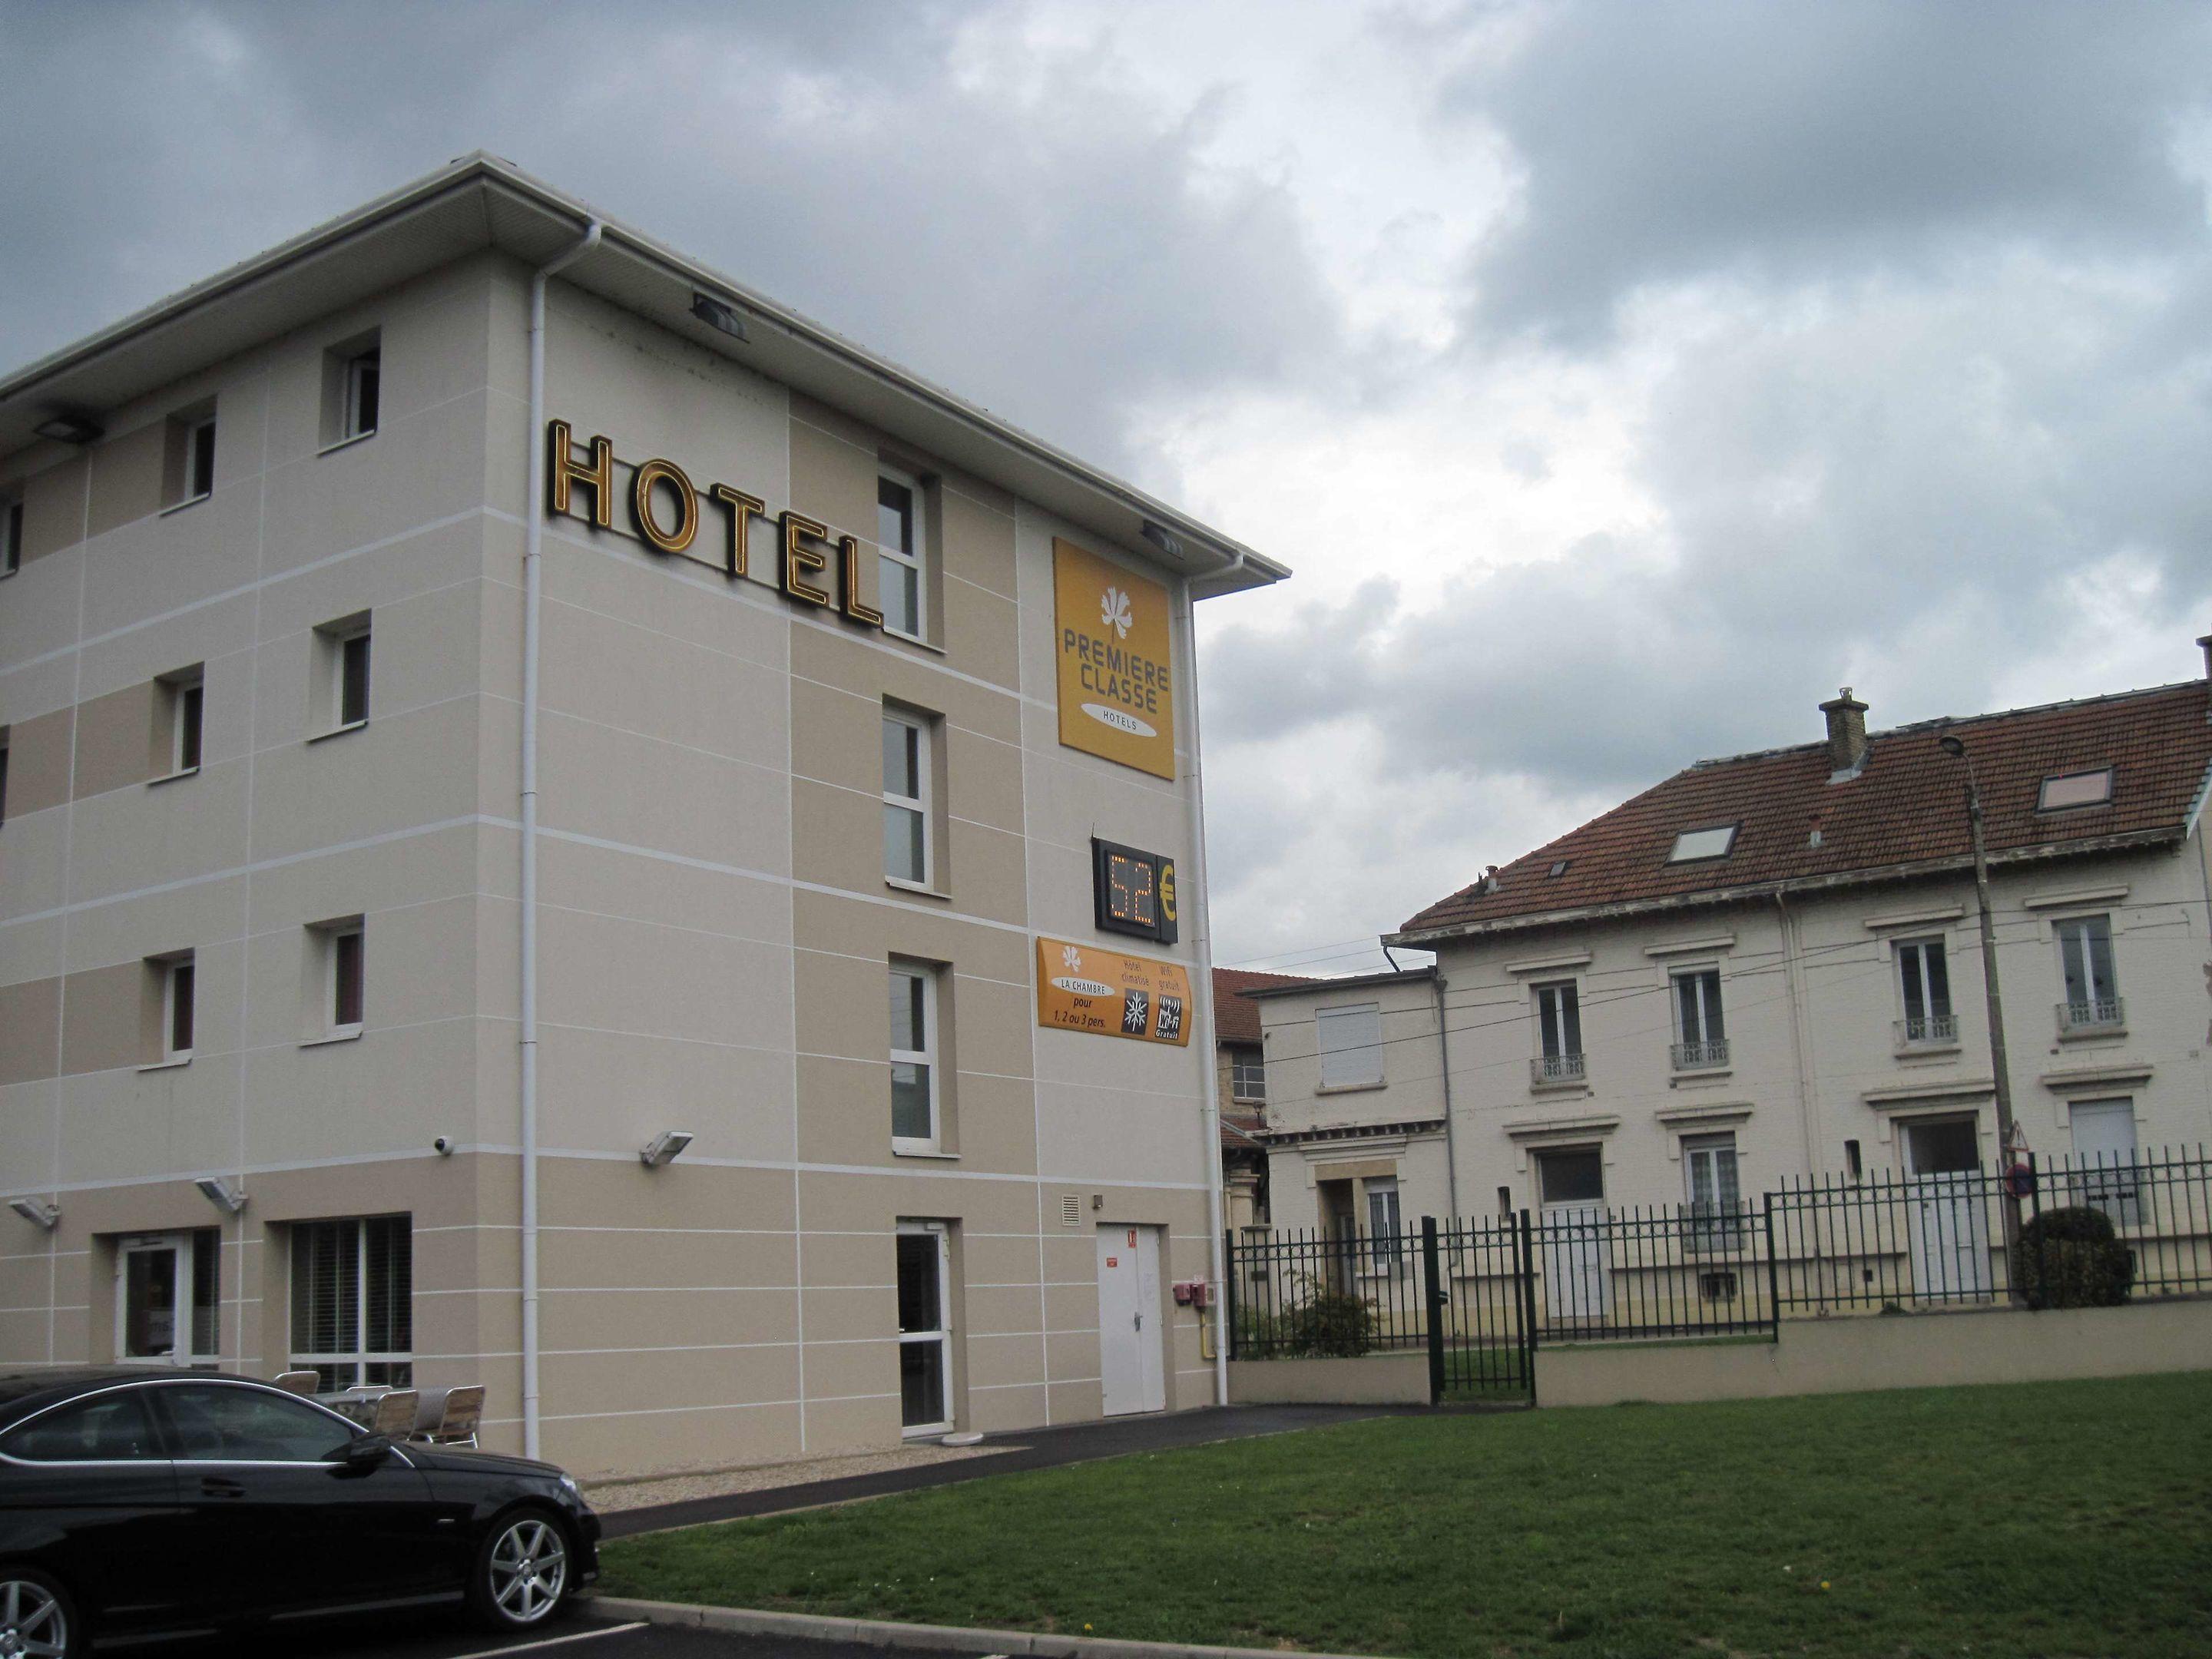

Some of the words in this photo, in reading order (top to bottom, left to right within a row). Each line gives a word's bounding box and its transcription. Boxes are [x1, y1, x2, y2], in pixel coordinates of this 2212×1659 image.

[548, 419, 884, 628] HOTEL
[1064, 628, 1168, 691] PREMIERE
[1080, 664, 1157, 714] CLASSE
[1104, 710, 1137, 730] HOTELS
[1061, 979, 1070, 988] LA
[1072, 981, 1105, 995] CHAMBRE
[1073, 998, 1092, 1008] pour
[1062, 1011, 1068, 1022] 2
[1069, 1015, 1079, 1024] ou
[1081, 1014, 1087, 1025] 3
[1088, 1017, 1105, 1028] pers.
[1155, 1029, 1178, 1040] Gratuit
